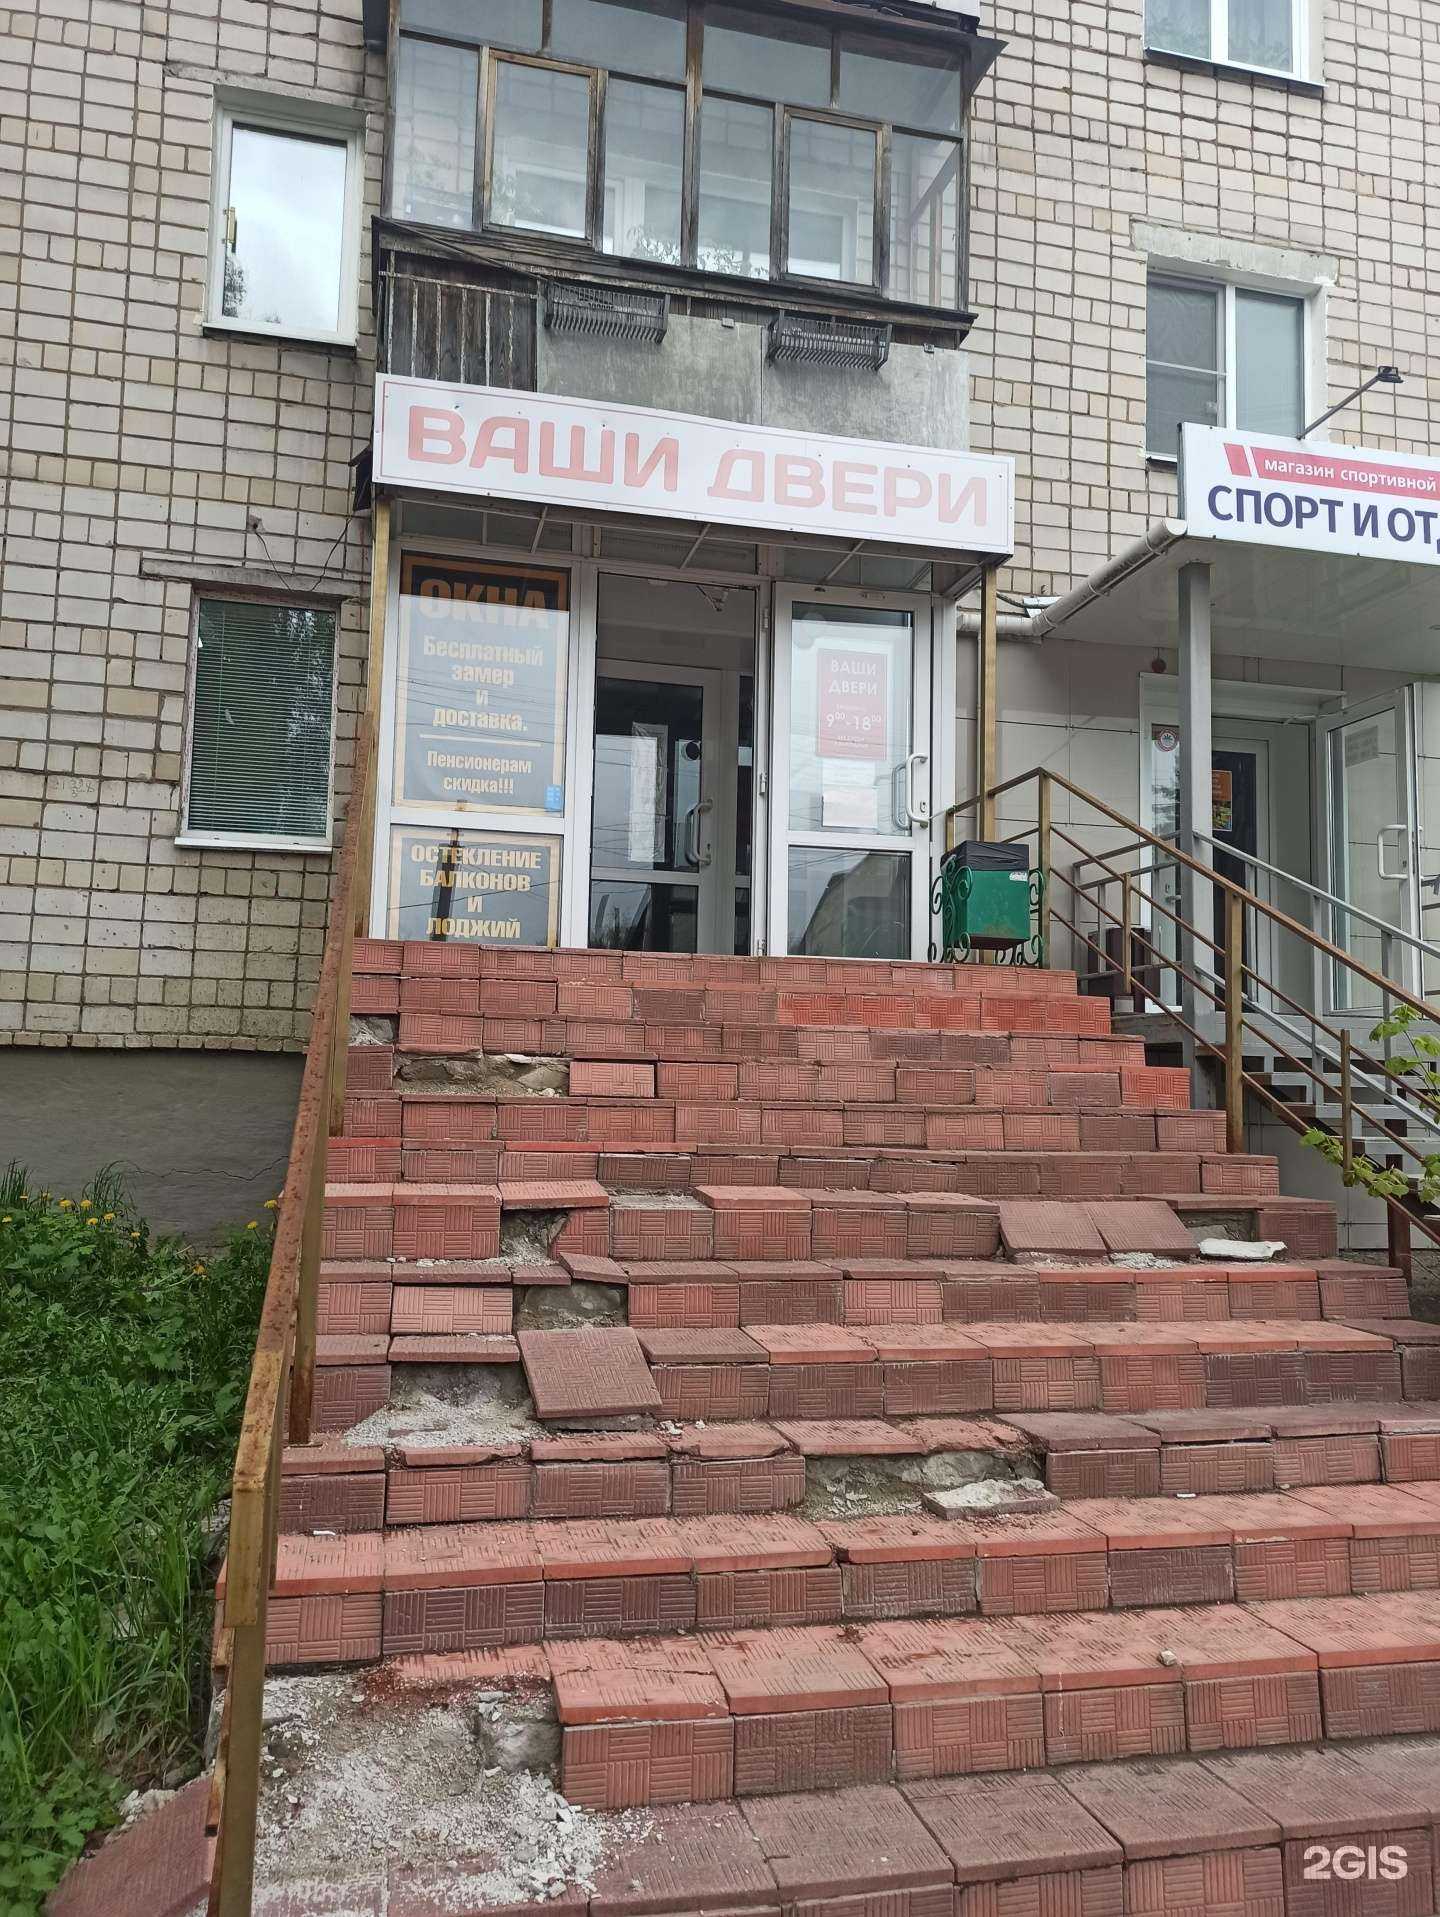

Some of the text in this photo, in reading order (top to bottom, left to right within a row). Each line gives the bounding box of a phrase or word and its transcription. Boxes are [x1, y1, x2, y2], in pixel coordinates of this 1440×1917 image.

[408, 405, 987, 527] ВАШИ ДВЕРИ
[1264, 460, 1436, 492] магазин спортивной
[1208, 485, 1440, 555] СПОРТ И ОТ
[417, 577, 549, 629] ОКНА
[423, 635, 544, 667] Бесплатный
[452, 665, 514, 688] замер
[831, 659, 876, 676] ВАШИ
[828, 680, 877, 696] ДВЕРИ
[427, 751, 532, 774] Пенсионерам
[443, 776, 513, 794] скидка!!!
[411, 844, 541, 869] ОСТЕКЛЕНИЕ
[420, 869, 531, 892] БАЛКОНОВ
[467, 896, 483, 913] И
[426, 917, 521, 939] ЛОДЖИЙ
